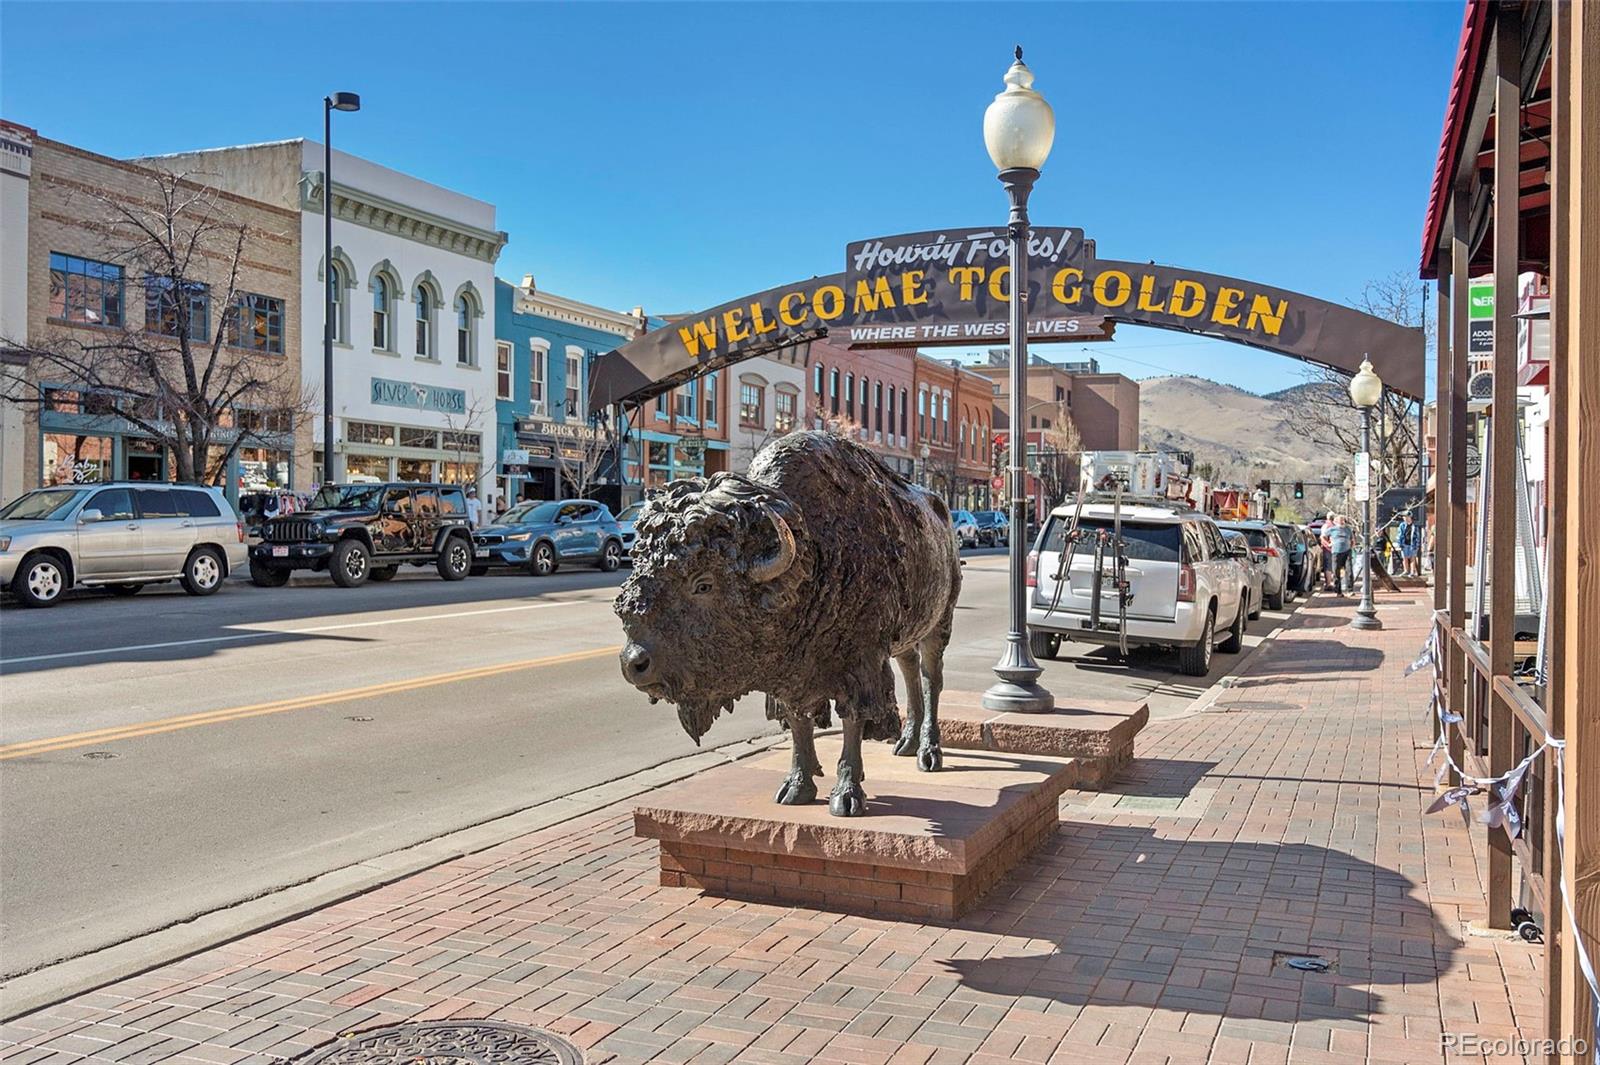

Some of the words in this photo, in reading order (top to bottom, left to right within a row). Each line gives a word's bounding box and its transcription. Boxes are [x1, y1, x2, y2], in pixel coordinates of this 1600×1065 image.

[854, 234, 963, 271] Howdy
[965, 230, 1072, 265] Foks!
[678, 269, 929, 357] WELCOME
[1052, 268, 1289, 336] GOLDEN
[850, 324, 916, 341] WHERE
[921, 323, 959, 338] THE
[964, 322, 1010, 337] WES
[1026, 319, 1080, 333] LIVES
[374, 381, 408, 404] SILVER
[432, 389, 462, 409] HORSE
[541, 422, 575, 437] BRICK
